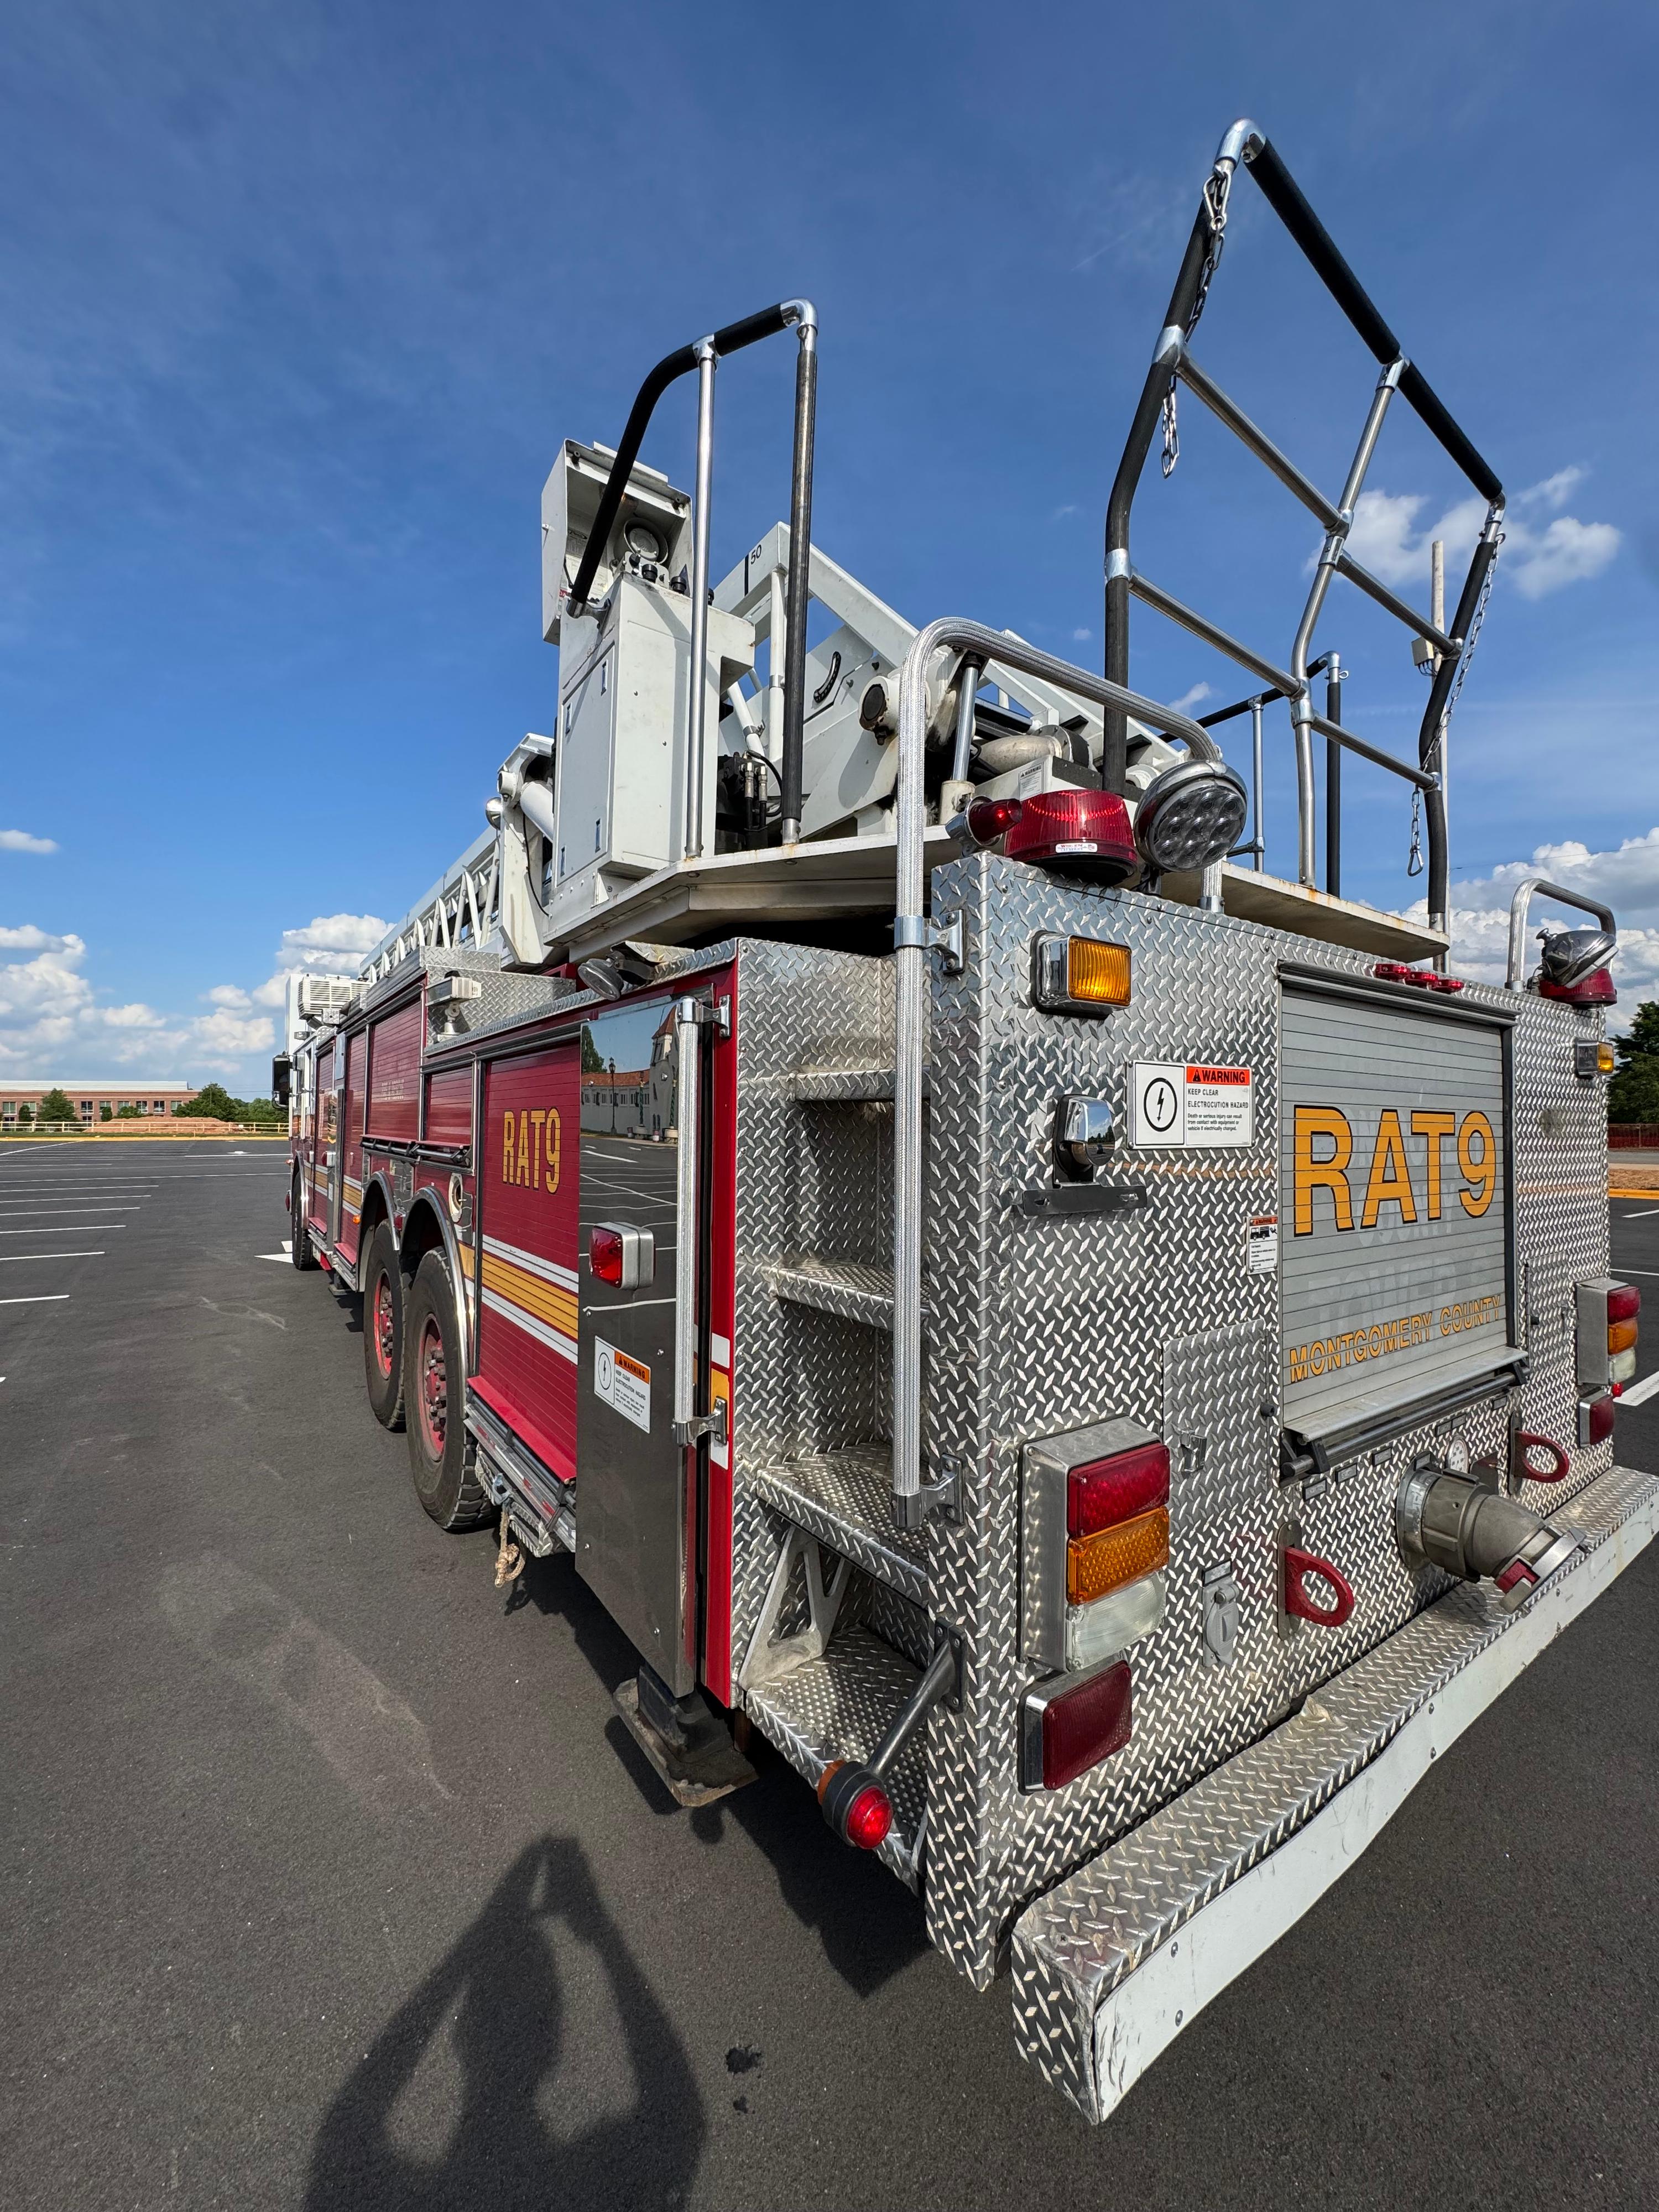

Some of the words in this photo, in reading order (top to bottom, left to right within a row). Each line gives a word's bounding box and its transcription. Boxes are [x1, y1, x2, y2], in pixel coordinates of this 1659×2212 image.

[751, 545, 761, 565] 50
[1202, 1070, 1245, 1083] WARNING
[502, 1107, 561, 1194] RAT9
[1293, 1104, 1496, 1237] RAT9
[1290, 1311, 1433, 1384] MONTGOMERY
[1439, 1294, 1501, 1336] COUNTY
[623, 1359, 645, 1379] WARNING
